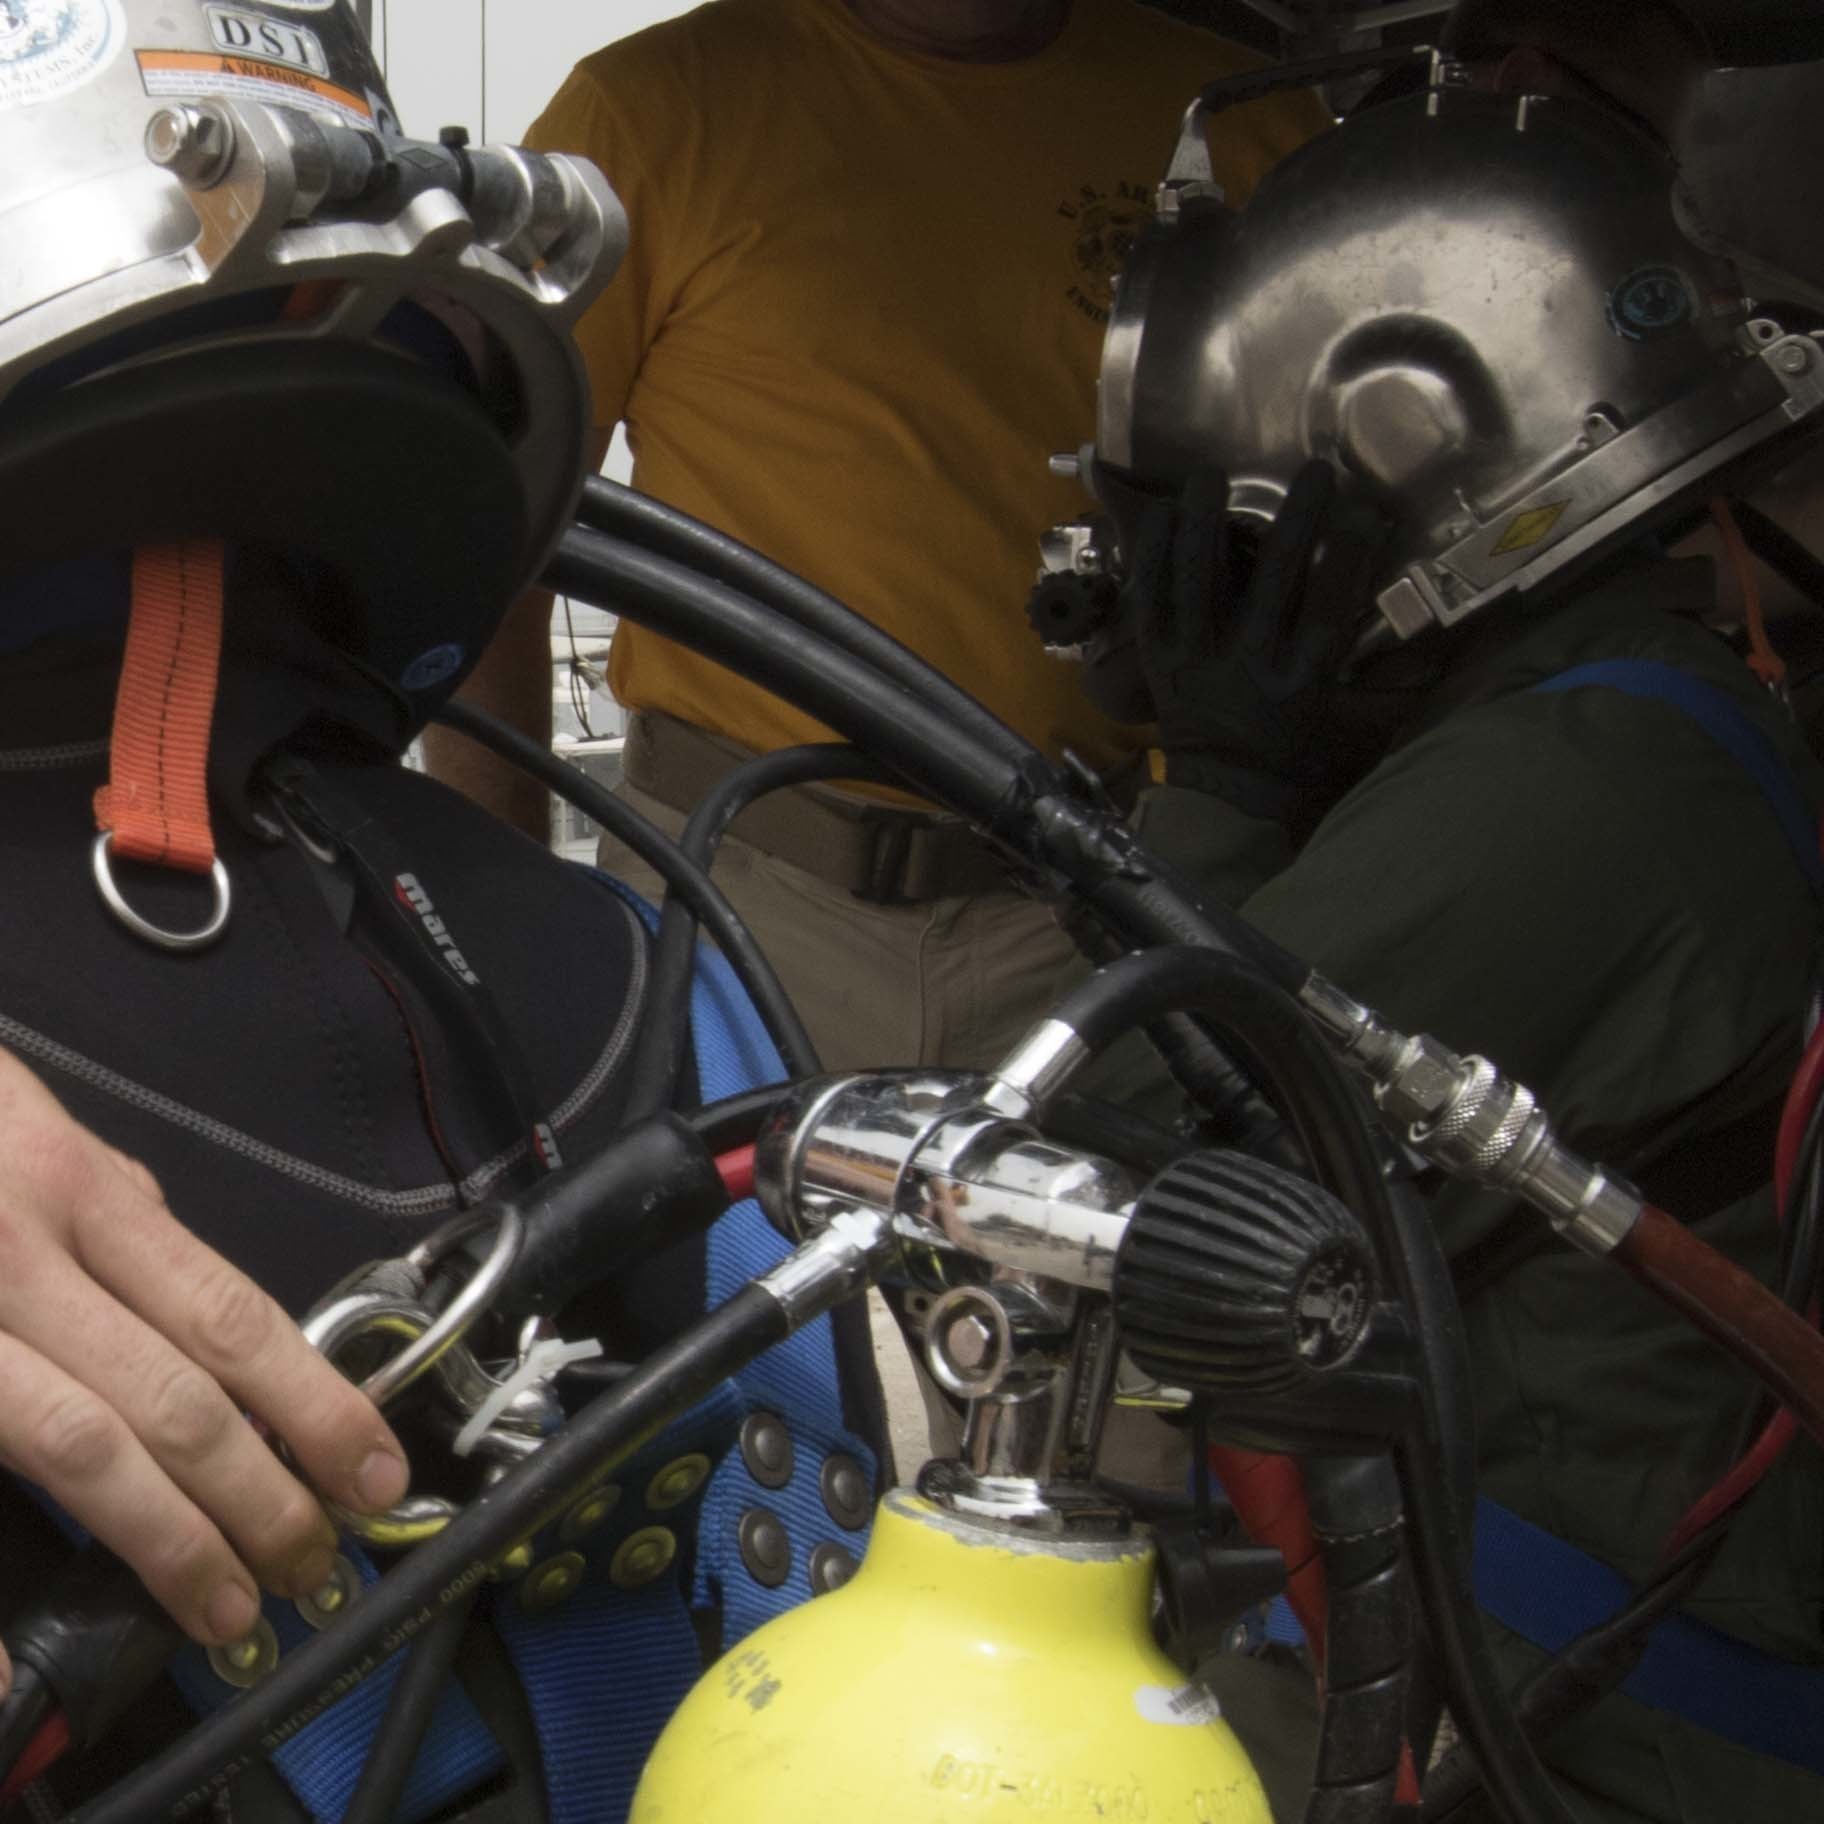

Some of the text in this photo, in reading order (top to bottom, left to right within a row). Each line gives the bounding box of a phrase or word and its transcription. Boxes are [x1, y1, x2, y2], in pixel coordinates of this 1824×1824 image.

[219, 16, 311, 64] DSI
[237, 60, 318, 92] WARNING
[393, 871, 481, 988] mares
